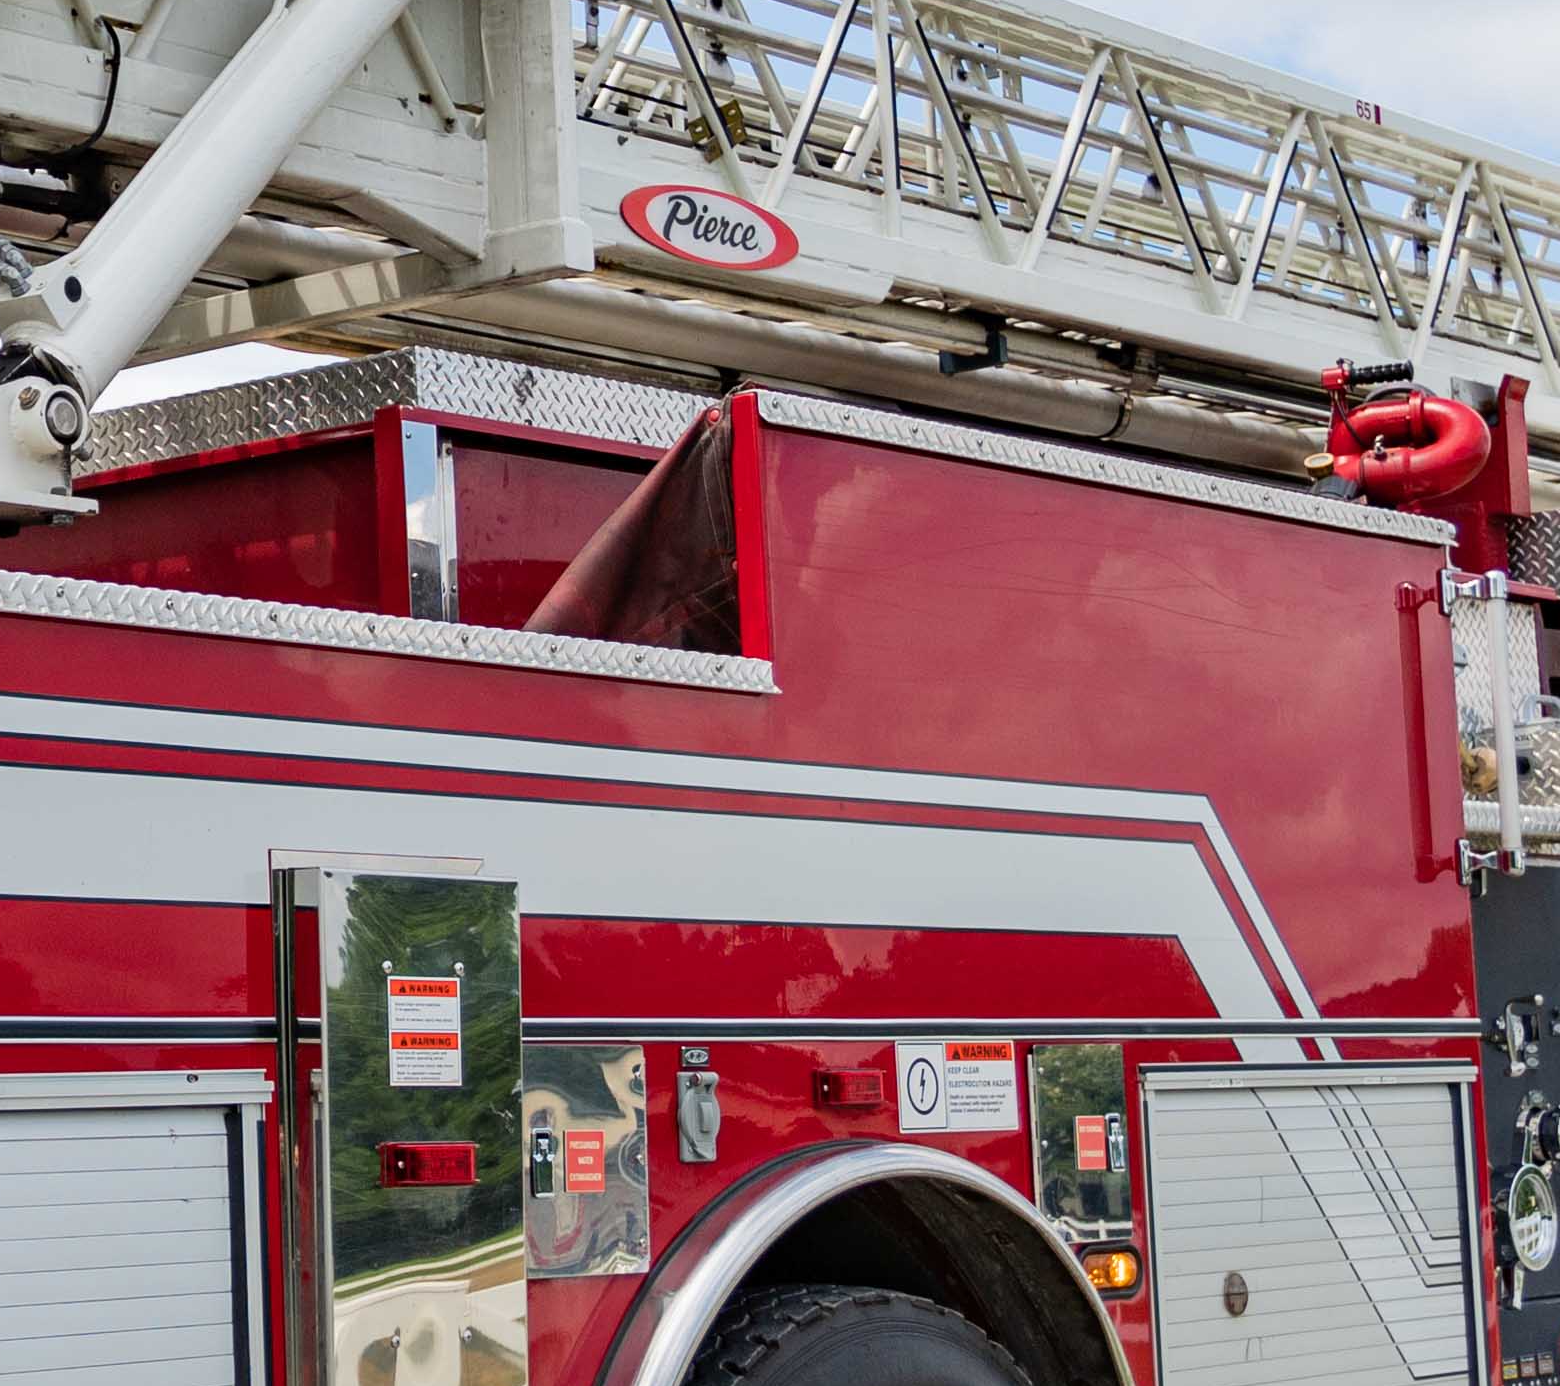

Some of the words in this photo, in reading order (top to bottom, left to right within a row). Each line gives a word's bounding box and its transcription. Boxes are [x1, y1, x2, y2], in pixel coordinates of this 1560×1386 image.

[1356, 99, 1371, 120] 65
[663, 194, 758, 251] Pierce
[409, 984, 450, 993] WARNING
[411, 1037, 451, 1046] WARNING
[961, 1045, 1007, 1058] WARNING
[962, 1066, 979, 1074] CLEAR
